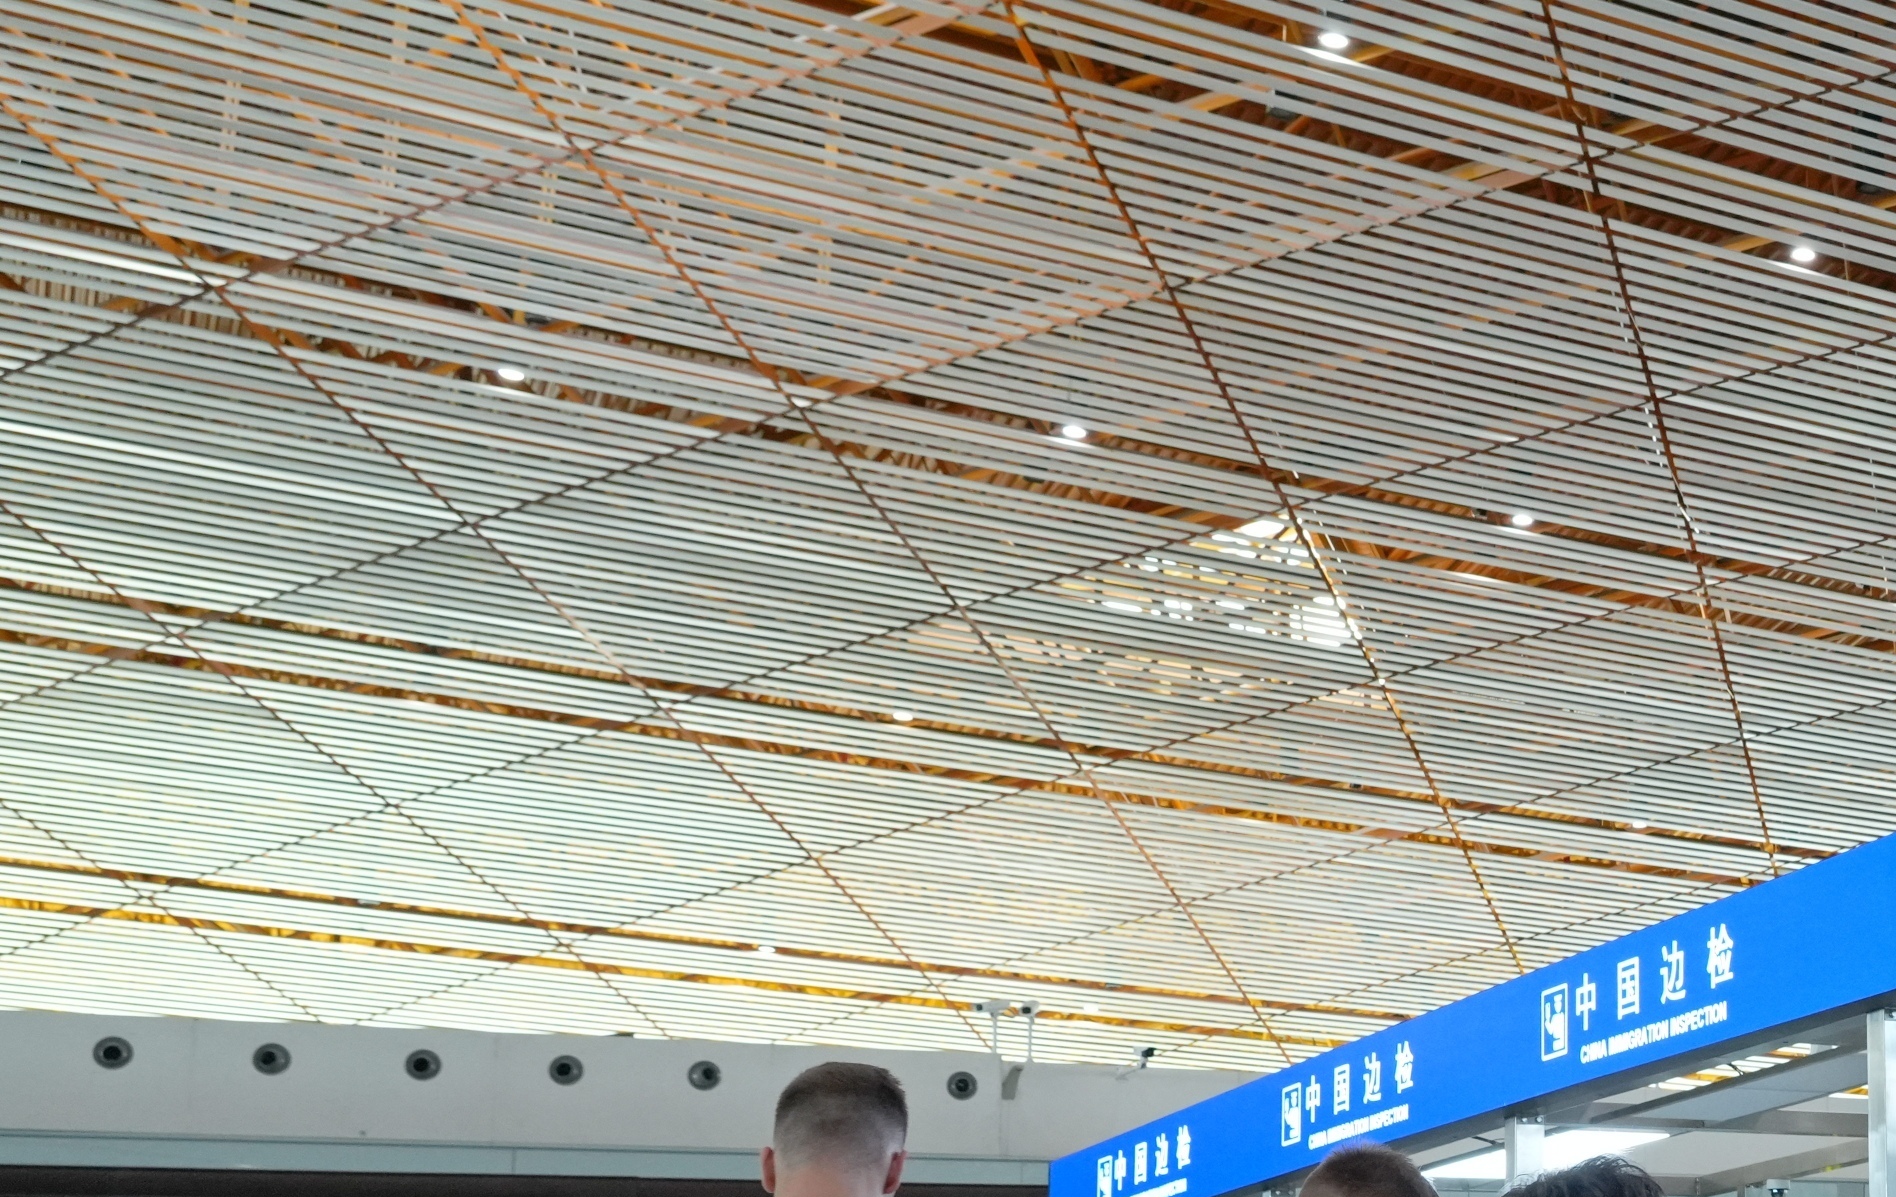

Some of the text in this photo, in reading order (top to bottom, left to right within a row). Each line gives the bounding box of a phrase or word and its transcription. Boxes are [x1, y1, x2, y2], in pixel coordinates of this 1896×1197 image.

[1575, 923, 1734, 1031] 中国边检
[1670, 1000, 1728, 1037] INSPECTION
[1305, 1040, 1414, 1123] 中国边检
